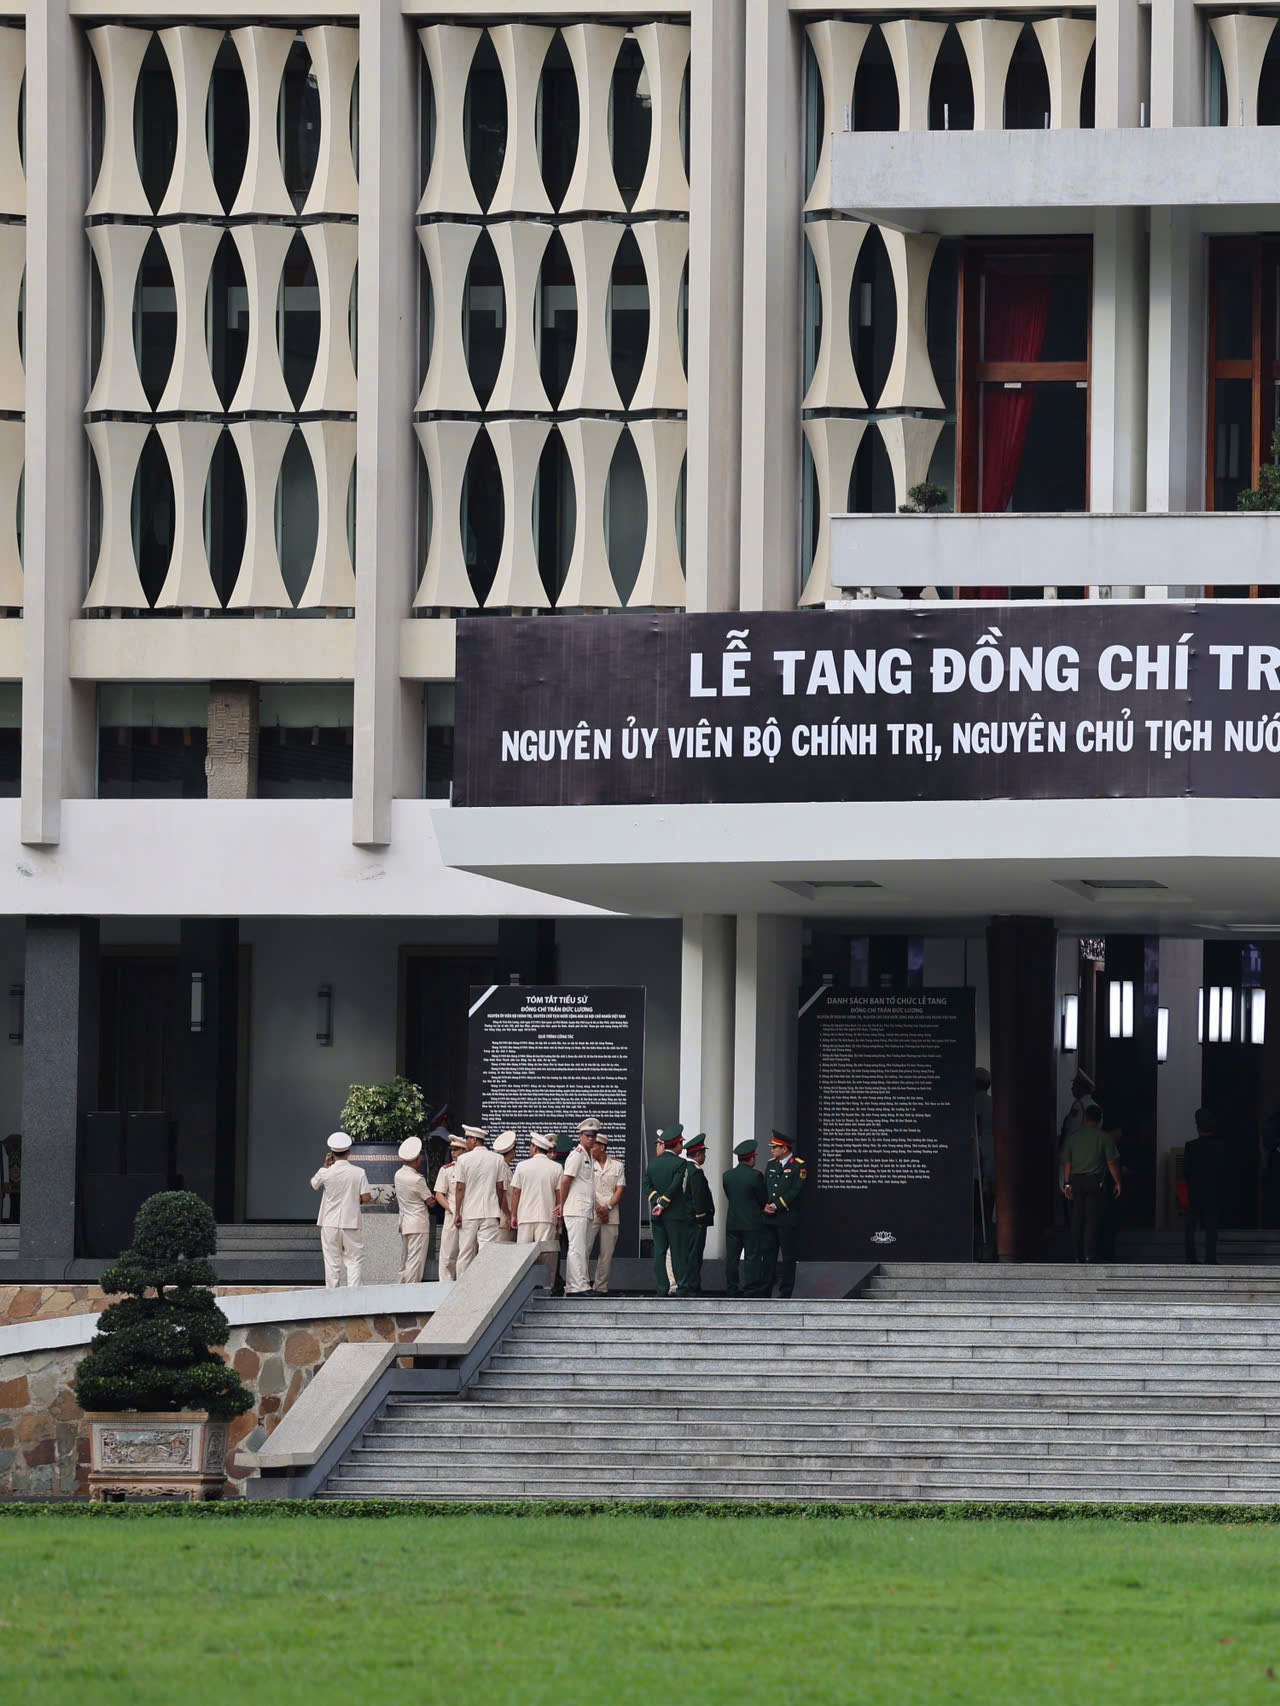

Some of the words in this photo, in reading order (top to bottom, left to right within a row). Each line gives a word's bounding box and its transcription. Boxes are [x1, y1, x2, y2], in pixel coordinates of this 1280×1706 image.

[690, 630, 752, 698] LỄ
[774, 648, 912, 696] TANG
[930, 626, 1080, 693] ĐỒNG
[1098, 632, 1194, 692] CHÍ
[501, 720, 612, 762] NGUYÊN
[622, 715, 658, 760] ỦY
[668, 718, 733, 759] VIÊN
[744, 716, 782, 764] BỘ
[791, 716, 877, 757] CHÍNH
[887, 723, 942, 762] TRỊ,
[953, 712, 1066, 754] NGUYÊN
[1076, 708, 1134, 753] CHỦ
[1145, 719, 1213, 760] TỊCH
[526, 995, 543, 1004] TÓM
[544, 994, 558, 1004] TẮT
[559, 994, 576, 1004] TIỂU
[577, 995, 588, 1004] SỬ
[827, 997, 848, 1005] DANH
[849, 996, 868, 1005] SÁCH
[869, 997, 885, 1005] BAN
[896, 996, 917, 1005] CHỨC
[927, 997, 947, 1005] TANG
